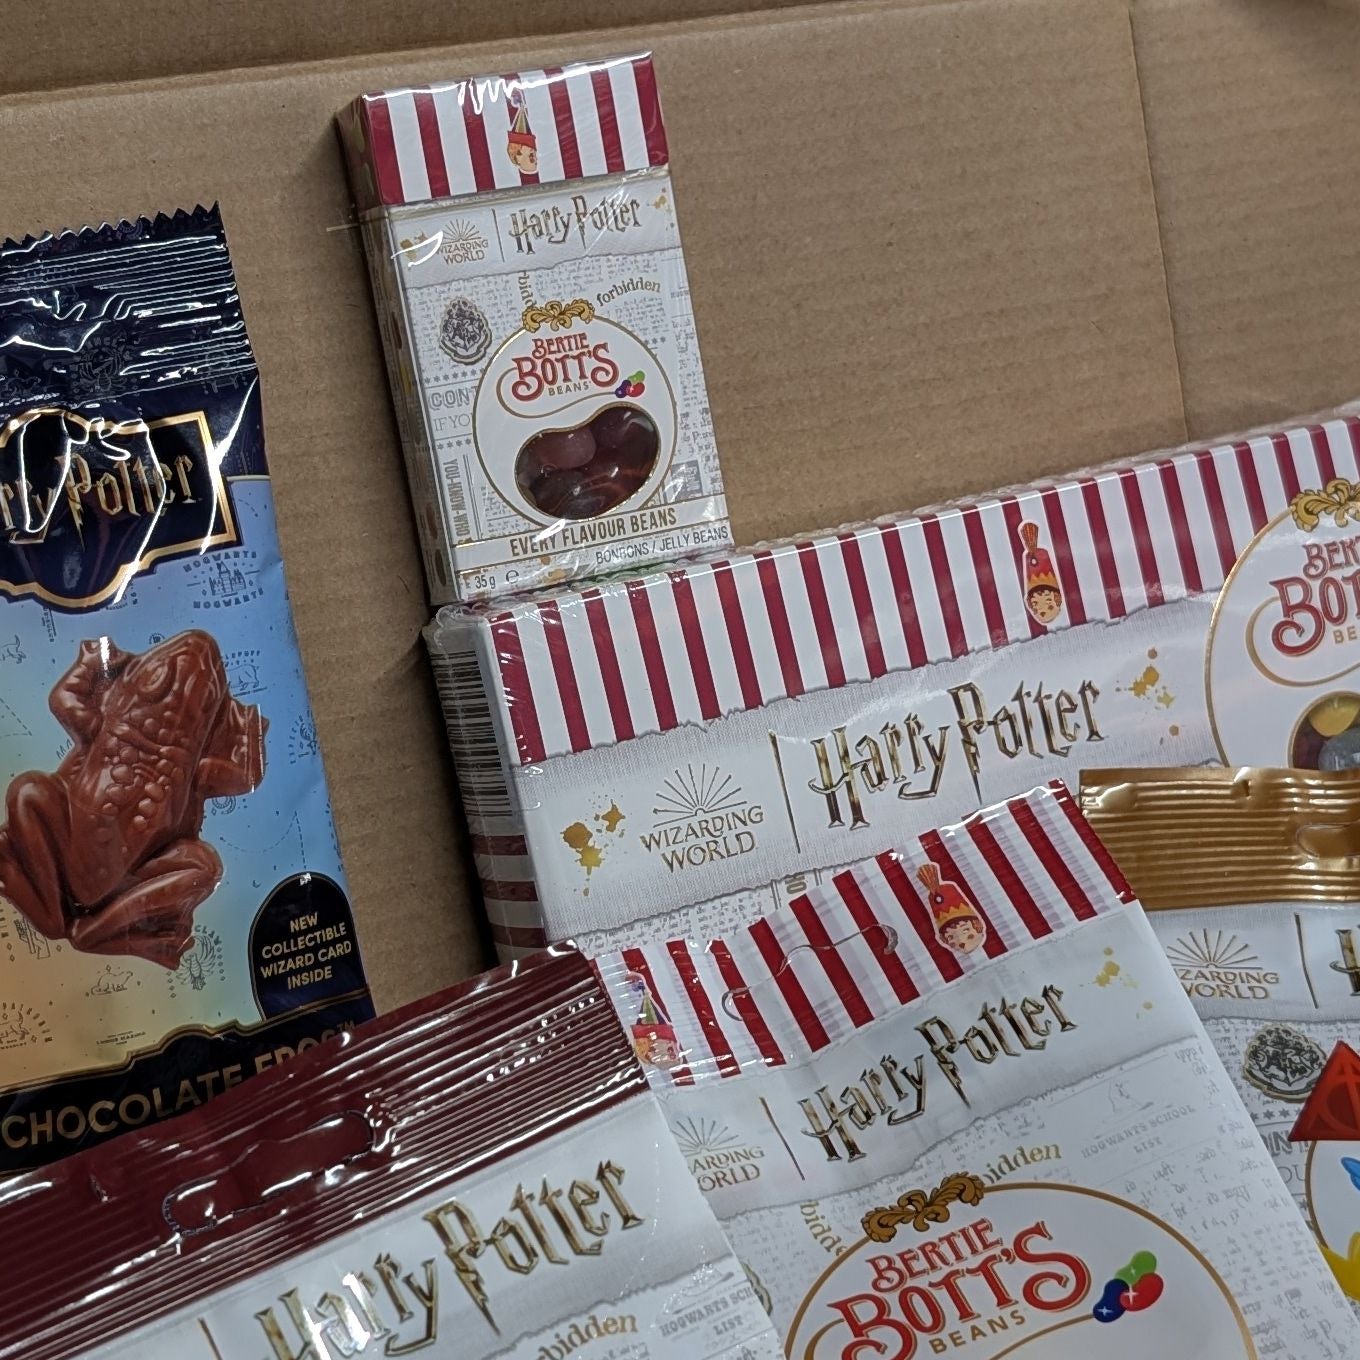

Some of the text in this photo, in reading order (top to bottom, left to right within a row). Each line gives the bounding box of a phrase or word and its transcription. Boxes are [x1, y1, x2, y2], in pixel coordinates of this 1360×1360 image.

[509, 194, 641, 255] Harry Potter
[437, 240, 489, 256] WIZARDING
[443, 249, 485, 265] WORLD
[596, 277, 661, 307] forbidden
[532, 332, 589, 360] BERTIE
[511, 341, 620, 402] BOTT'S
[548, 383, 590, 397] BEANS
[449, 413, 472, 429] YO
[53, 453, 196, 552] Potter
[511, 507, 678, 558] EVERY FLAVOUR BEANS
[659, 534, 692, 552] JELLY
[693, 525, 730, 545] BEANS
[808, 679, 1108, 832] Harry Potter
[639, 806, 765, 854] WIZARDING
[660, 831, 758, 874] WORLD
[261, 922, 348, 959] COLLECTIBLE
[289, 912, 319, 933] NEW
[259, 940, 353, 979] WIZARD CARD
[287, 965, 333, 990] INSIDE
[1177, 968, 1280, 985] ZARDING
[797, 983, 1078, 1164] Harry Potter
[1, 1064, 242, 1149] CHOCOLATE
[691, 1146, 766, 1173] ARDING
[697, 1163, 761, 1191] ORLD
[422, 1159, 645, 1337] Potter
[865, 1216, 1004, 1293] BERTIE
[712, 1314, 744, 1337] LIST
[928, 1309, 1027, 1354] BEANS
